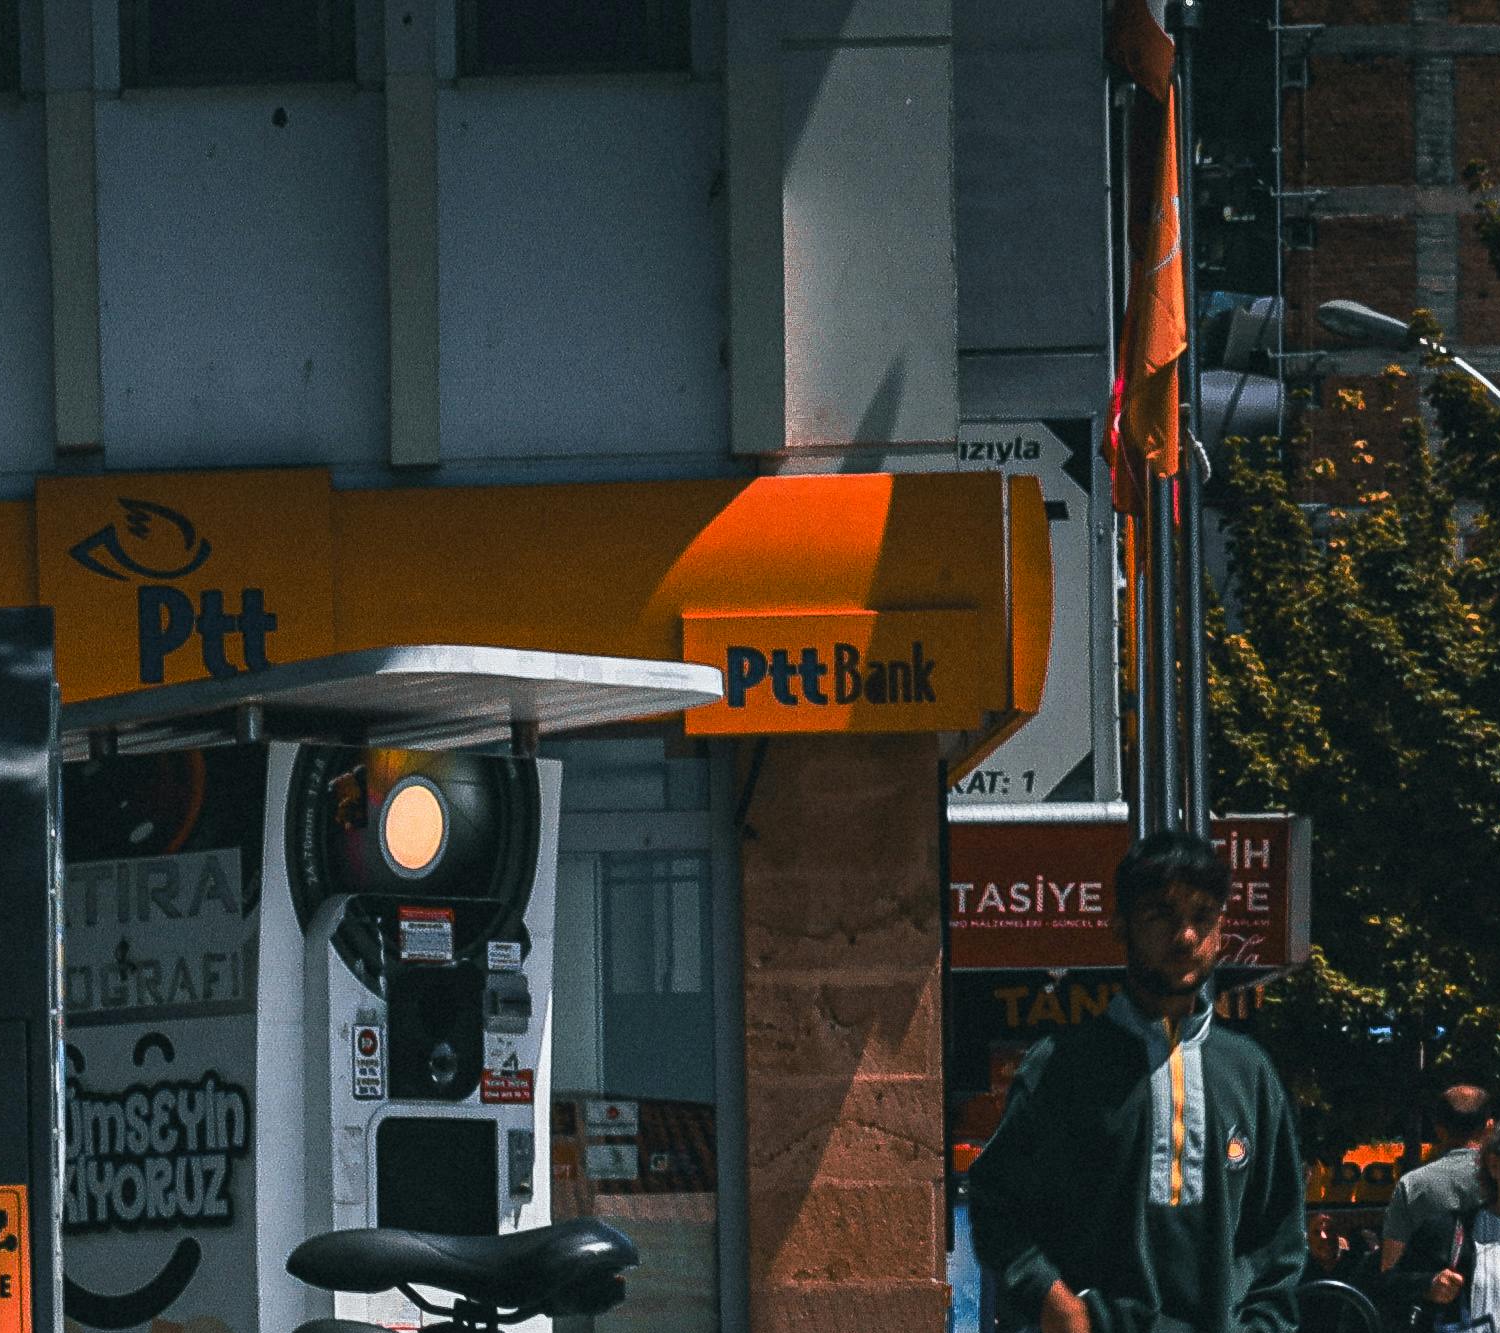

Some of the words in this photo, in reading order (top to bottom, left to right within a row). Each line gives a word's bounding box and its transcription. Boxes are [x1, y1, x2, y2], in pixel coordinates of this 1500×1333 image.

[137, 584, 278, 684] Ptt
[1022, 771, 1037, 793] 1
[66, 855, 240, 928] TIRA
